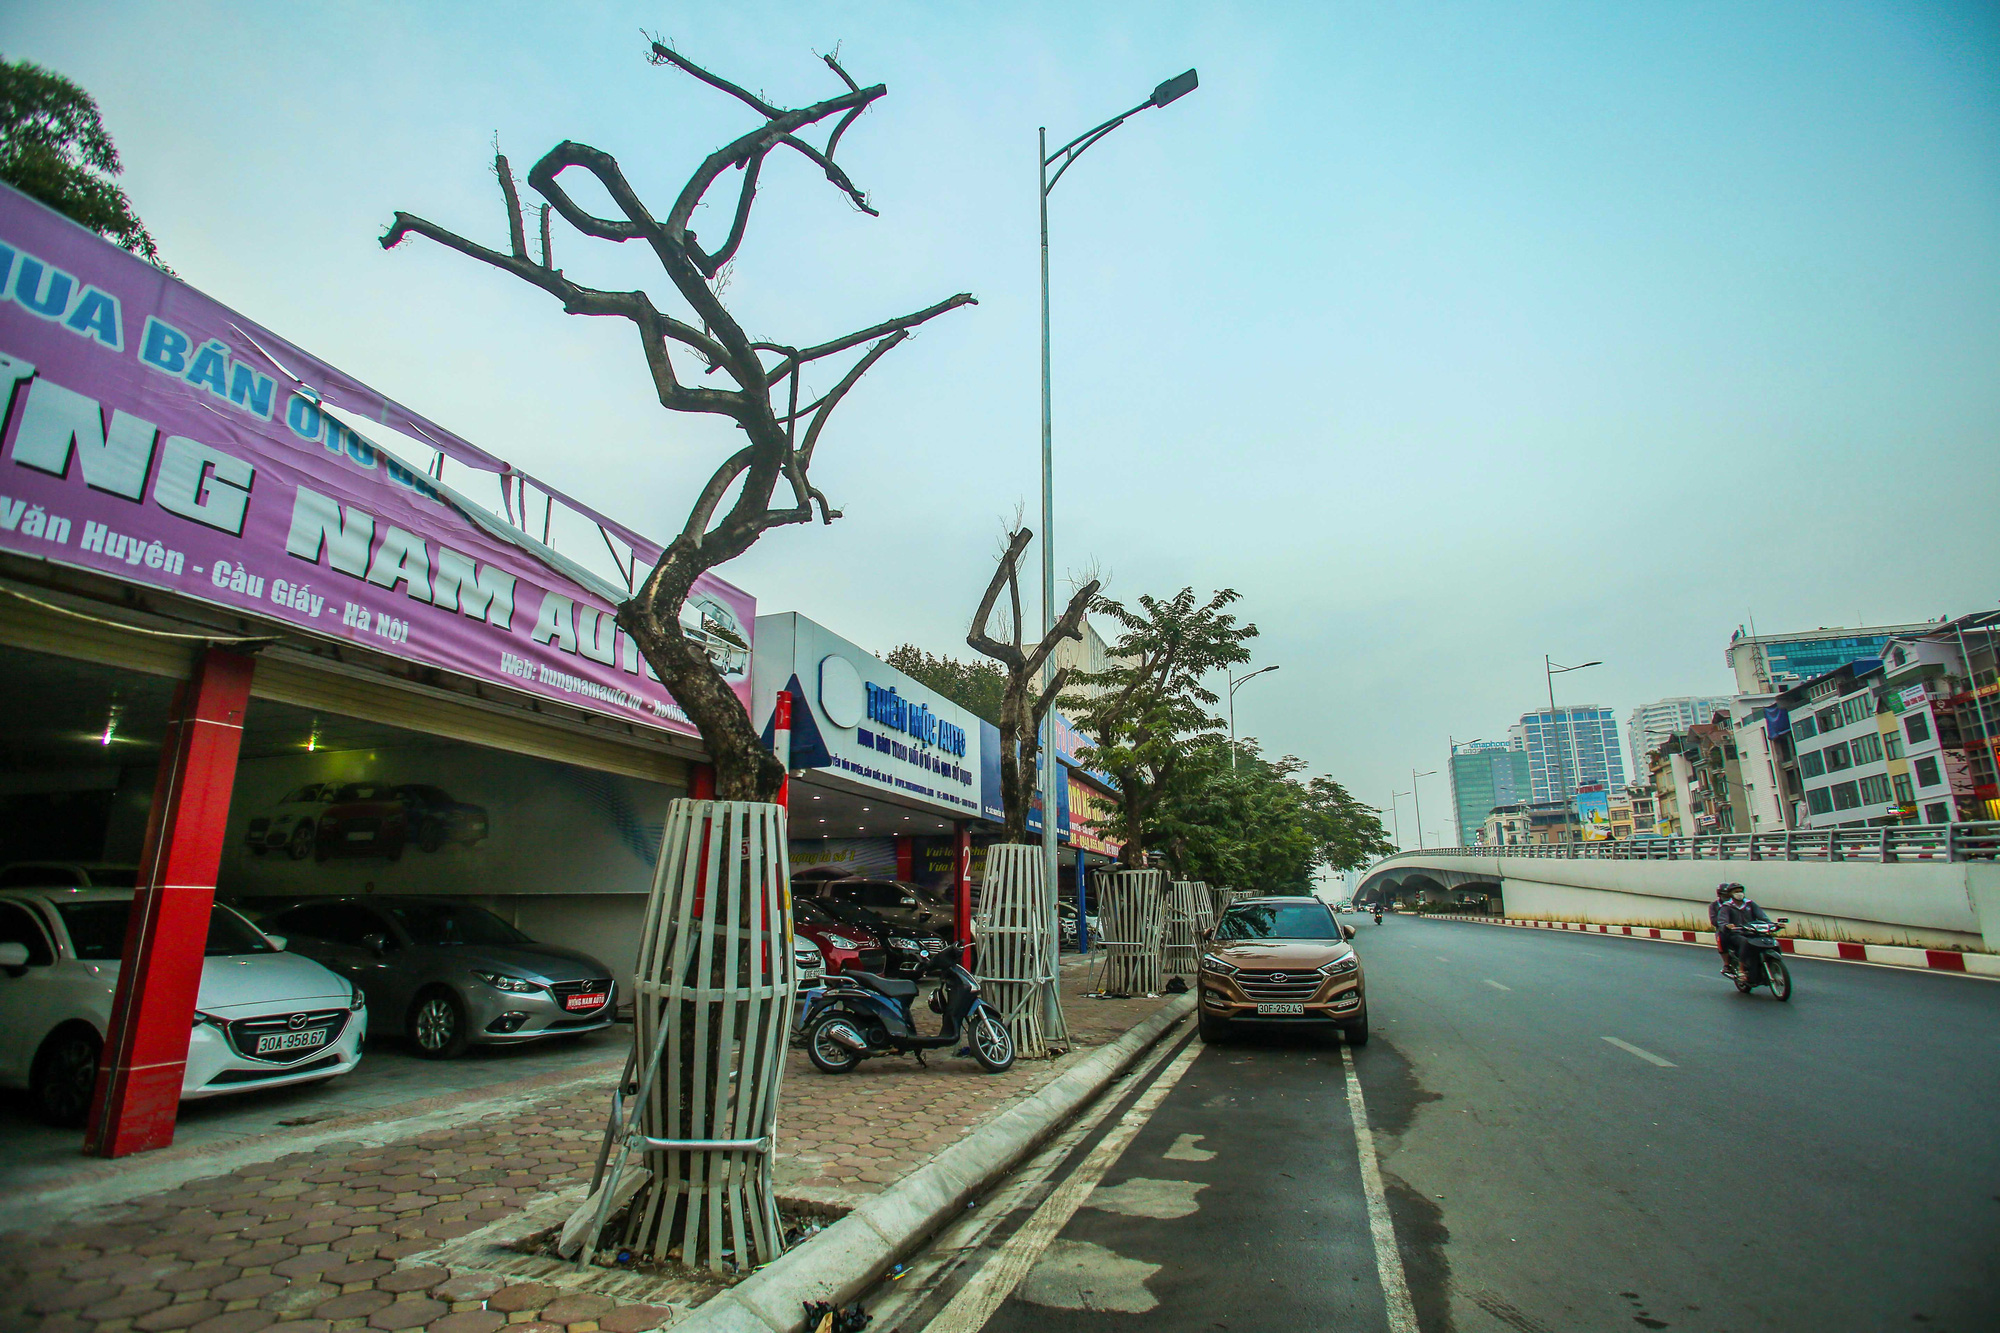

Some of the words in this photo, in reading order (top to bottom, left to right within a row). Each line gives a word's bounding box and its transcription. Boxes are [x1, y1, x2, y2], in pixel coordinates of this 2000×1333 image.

[0, 242, 123, 352] UA
[138, 315, 278, 421] BÁN
[0, 495, 72, 545] Văn
[80, 519, 186, 575] Huyên
[211, 560, 265, 598] Cầu
[270, 578, 325, 618] Giấy
[342, 601, 372, 632] Hà
[375, 612, 410, 645] Nội
[285, 484, 517, 632] NAM
[500, 651, 537, 681] Web:
[538, 662, 643, 711] hungnamauto.vn
[865, 681, 908, 734] THIÊN
[908, 702, 938, 749] MỘC
[938, 719, 966, 758] AUTO
[962, 845, 971, 881] 2
[259, 1030, 325, 1051] 30A-958.67
[1258, 1004, 1303, 1013] 30F-252.43
